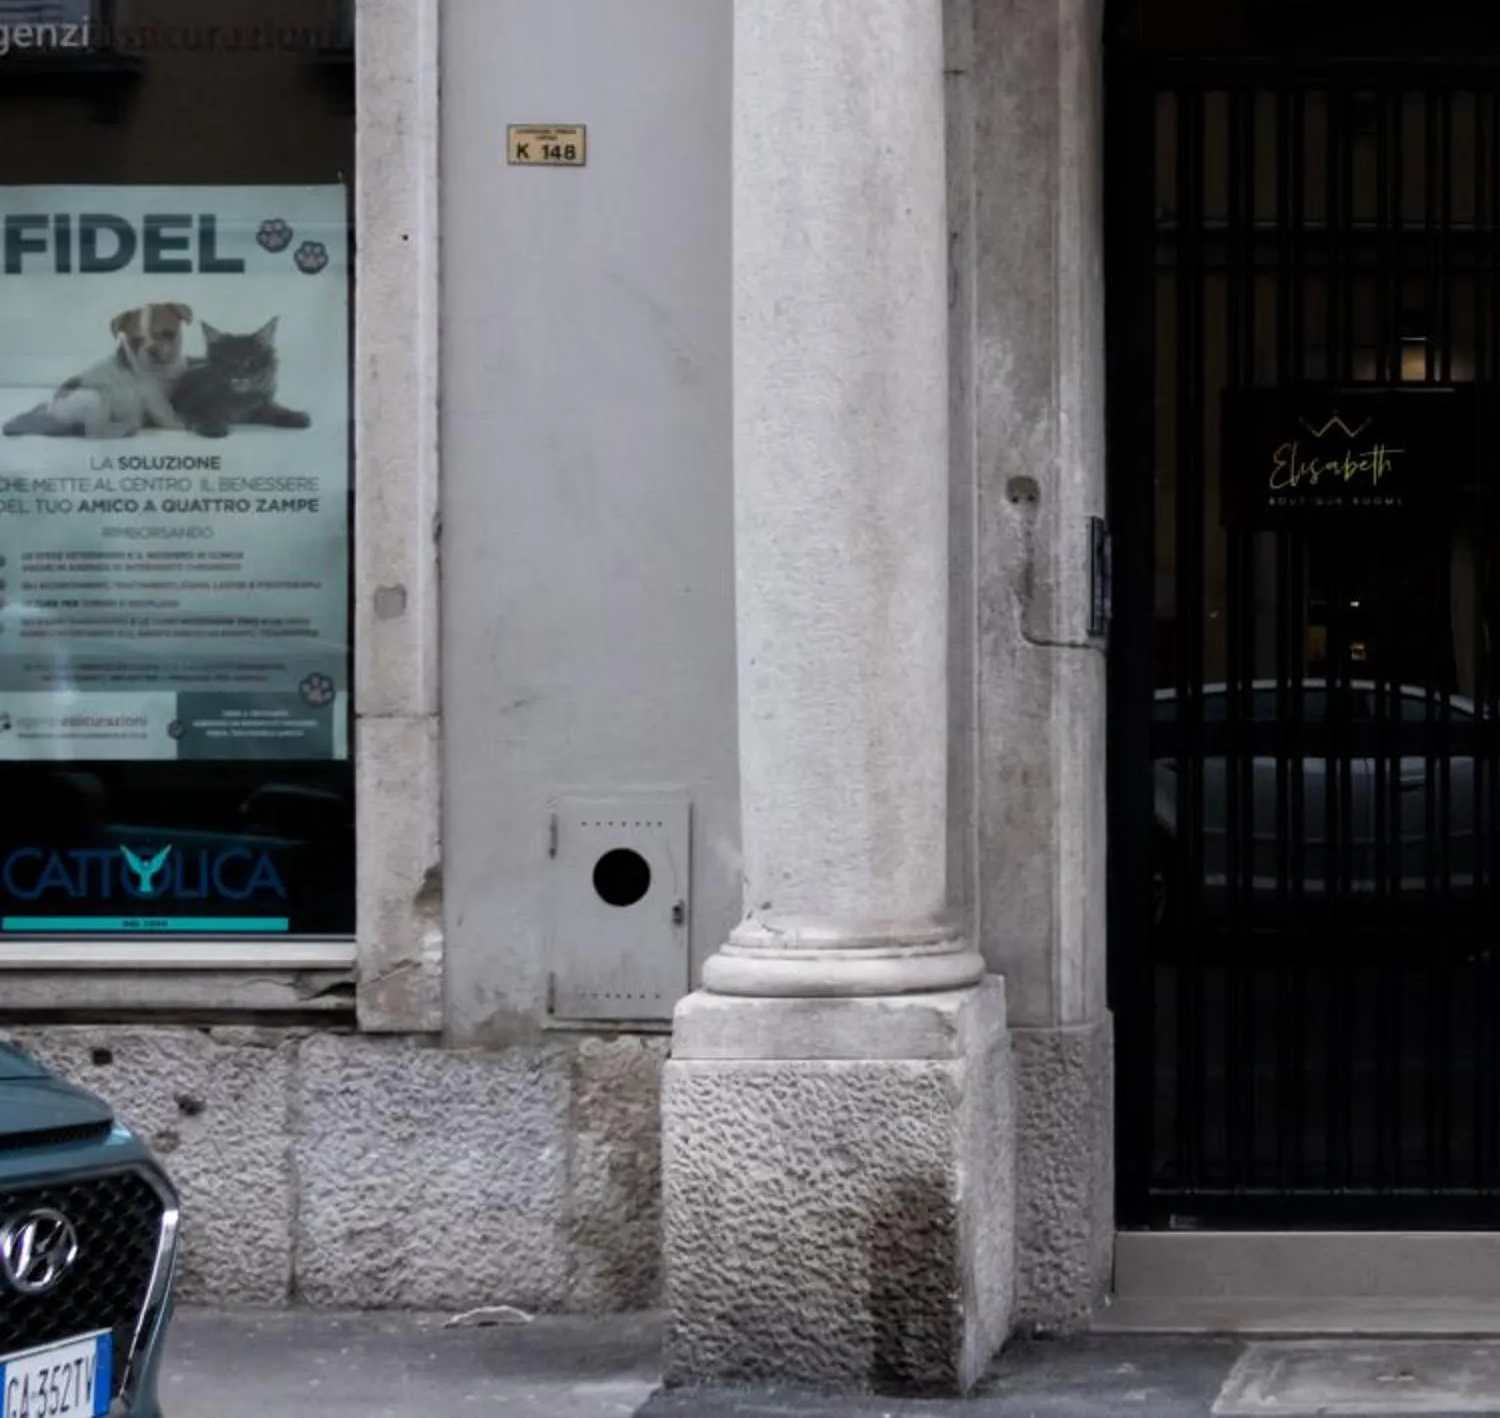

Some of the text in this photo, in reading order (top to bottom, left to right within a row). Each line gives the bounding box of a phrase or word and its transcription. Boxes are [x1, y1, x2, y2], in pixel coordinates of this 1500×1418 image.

[516, 142, 577, 161] K 148
[5, 213, 246, 275] FIDEL
[90, 455, 221, 471] LA SOLUZIONE
[1269, 439, 1407, 490] Elisabeth
[32, 477, 91, 493] METTE
[94, 477, 117, 493] AL
[120, 477, 193, 493] CENTRO
[218, 476, 320, 493] BENESSERE
[35, 498, 73, 514] TUO
[77, 498, 139, 514] AMICO
[143, 499, 157, 513] A
[161, 498, 251, 514] QUATTRO
[255, 498, 320, 514] ZAMPE
[2, 845, 288, 900] CATTOLICA
